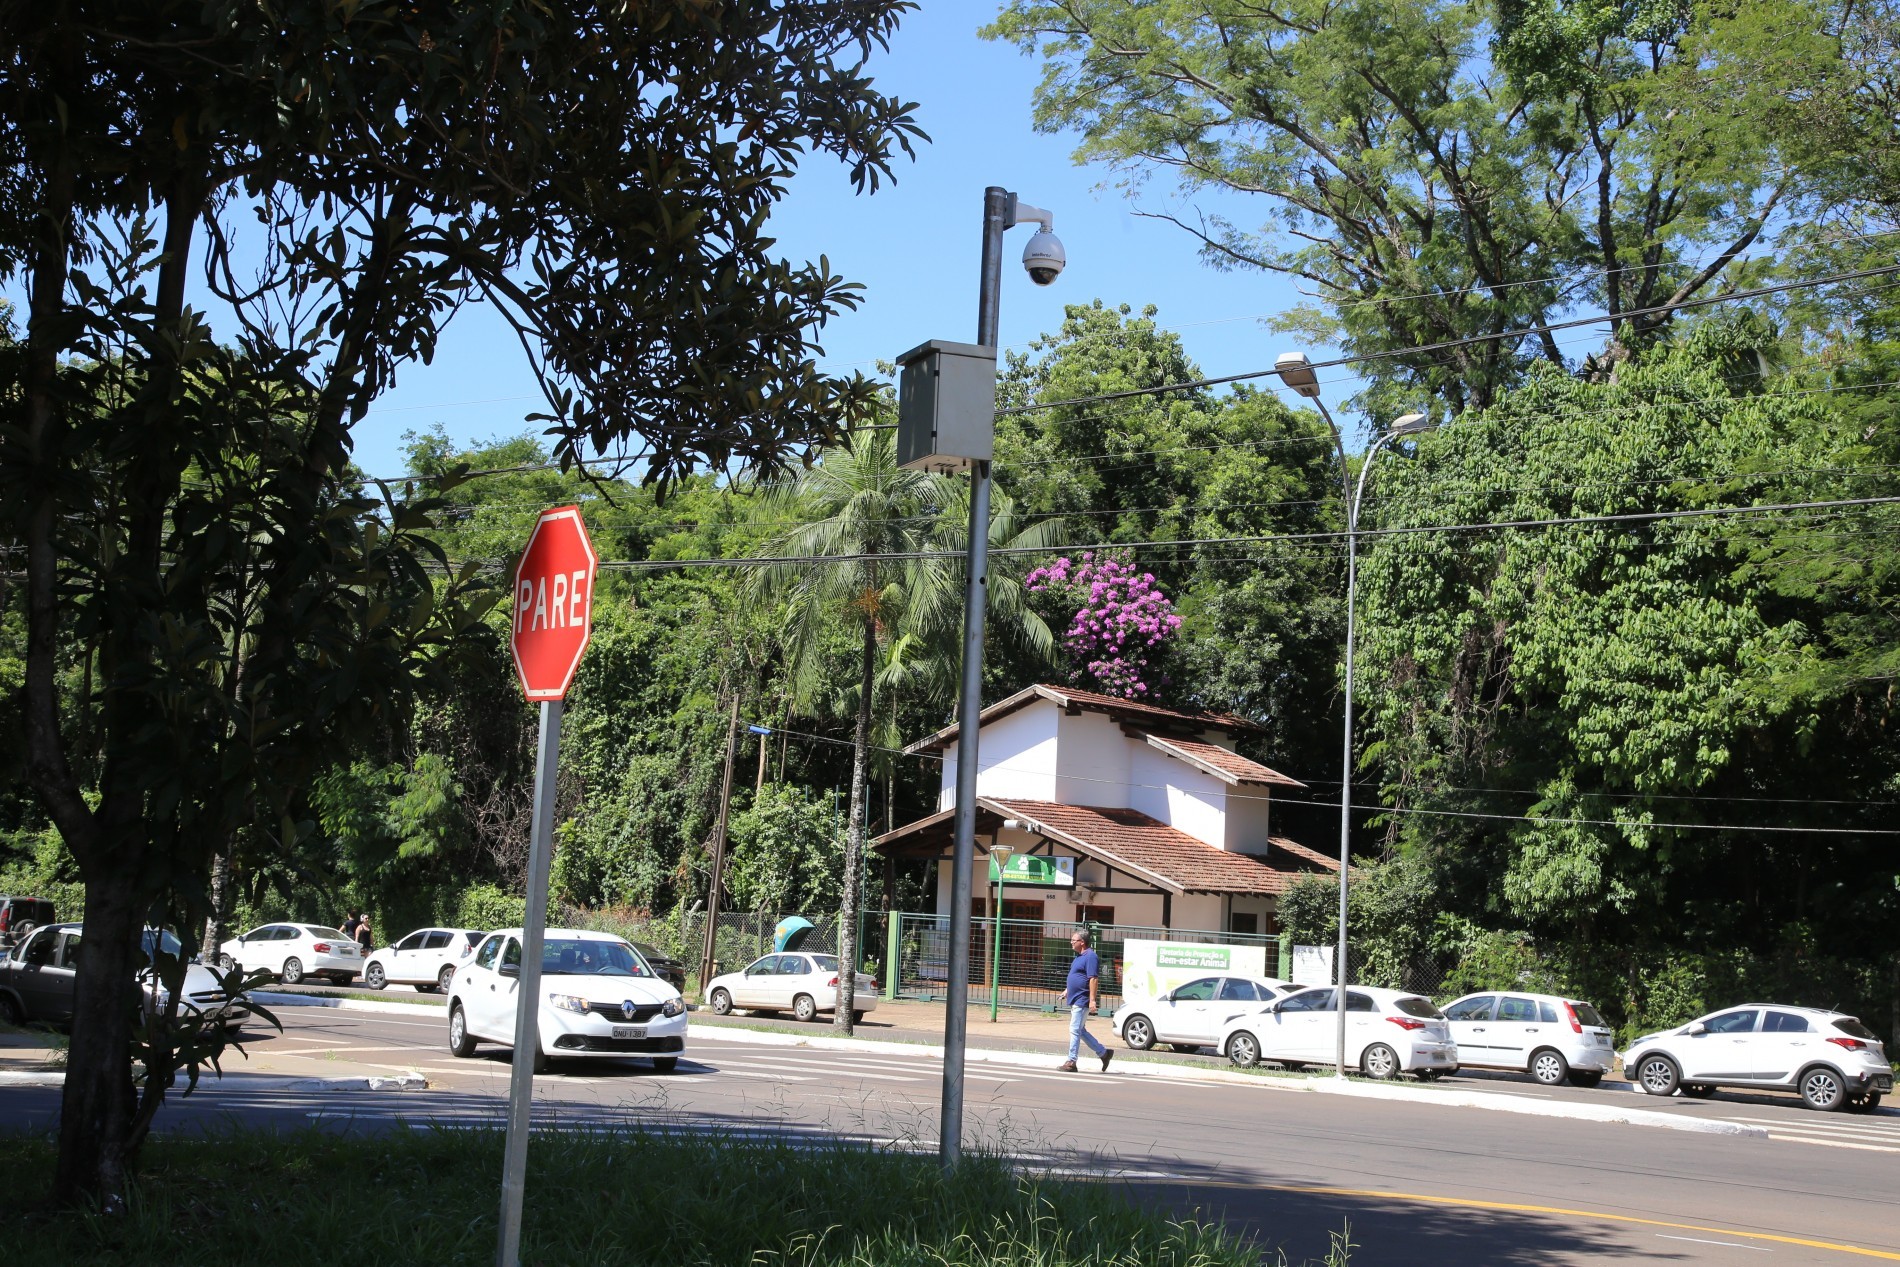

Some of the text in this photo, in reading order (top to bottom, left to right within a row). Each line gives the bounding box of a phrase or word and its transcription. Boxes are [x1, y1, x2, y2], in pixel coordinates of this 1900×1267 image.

[517, 570, 586, 634] PARE
[1159, 955, 1227, 968] Bem-estar Animal
